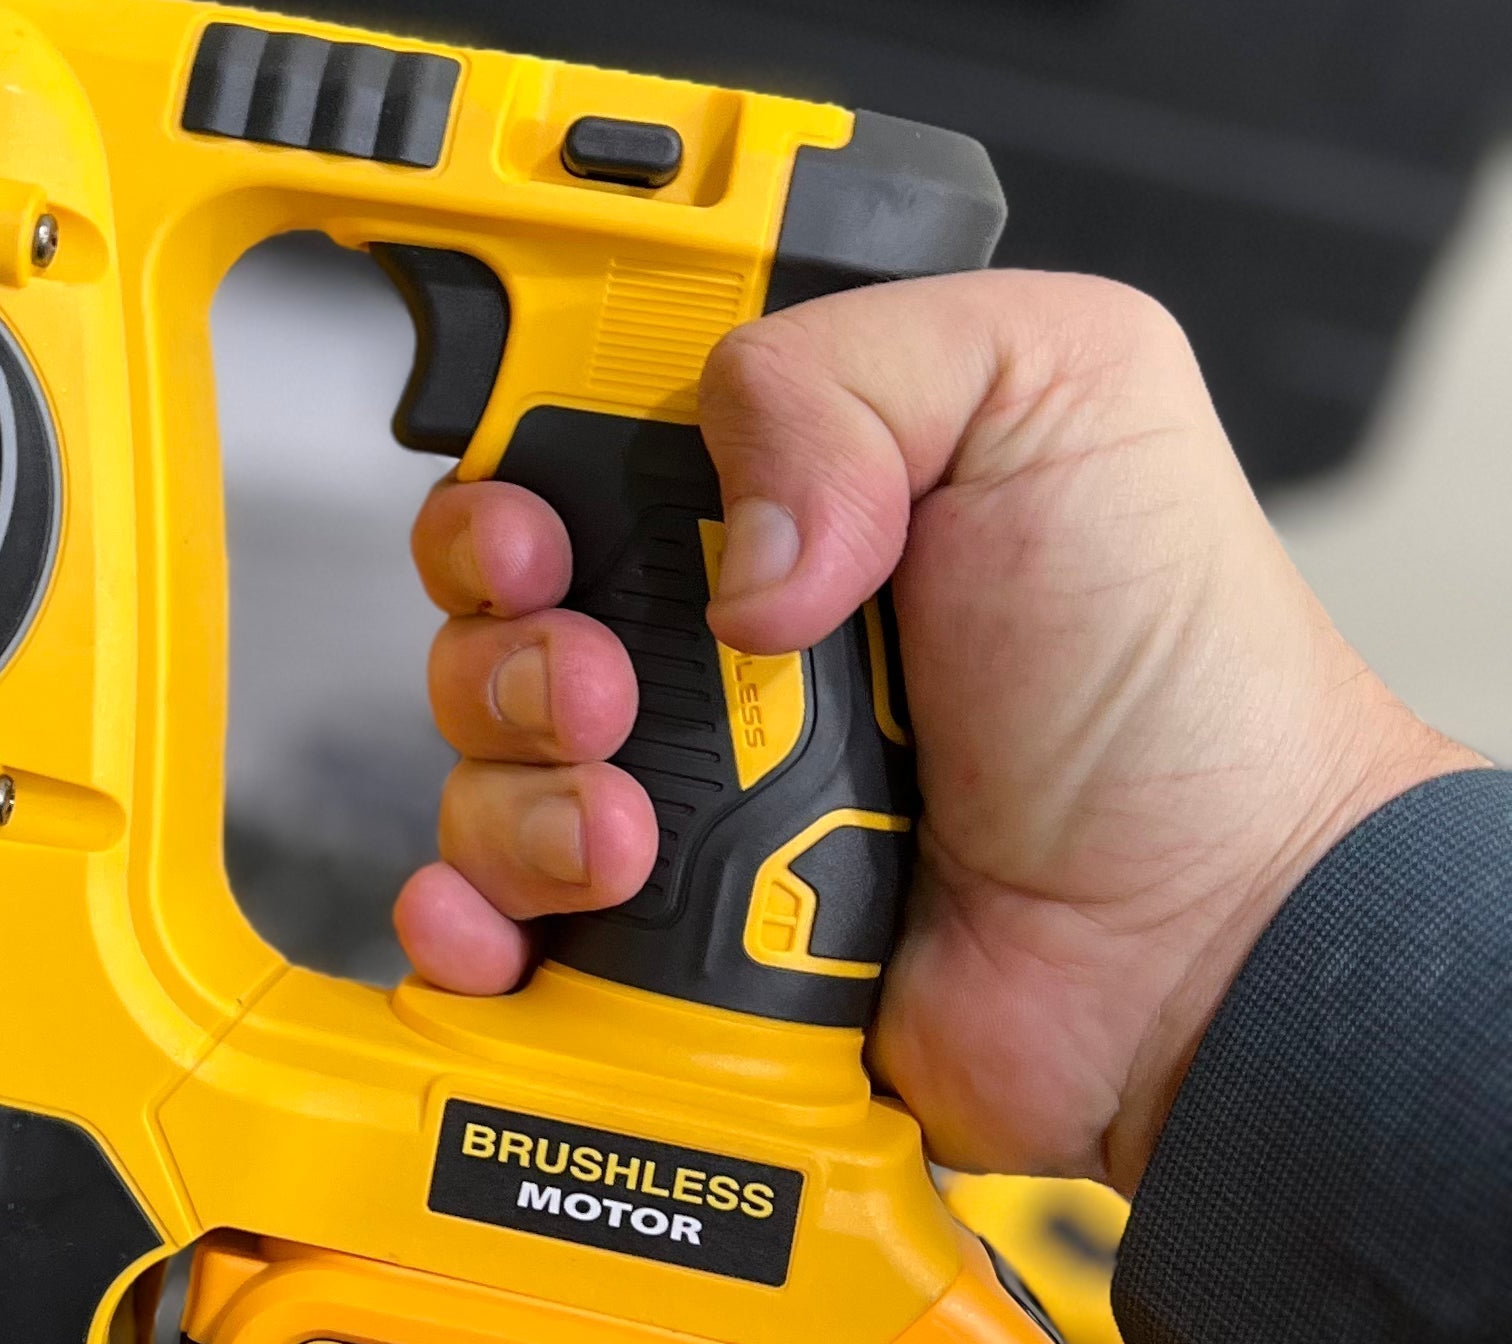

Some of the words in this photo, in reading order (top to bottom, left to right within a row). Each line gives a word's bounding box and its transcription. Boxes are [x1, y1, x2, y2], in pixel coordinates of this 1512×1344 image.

[732, 653, 766, 749] LESS
[461, 1122, 775, 1220] BRUSHLESS
[516, 1180, 704, 1246] MOTOR
